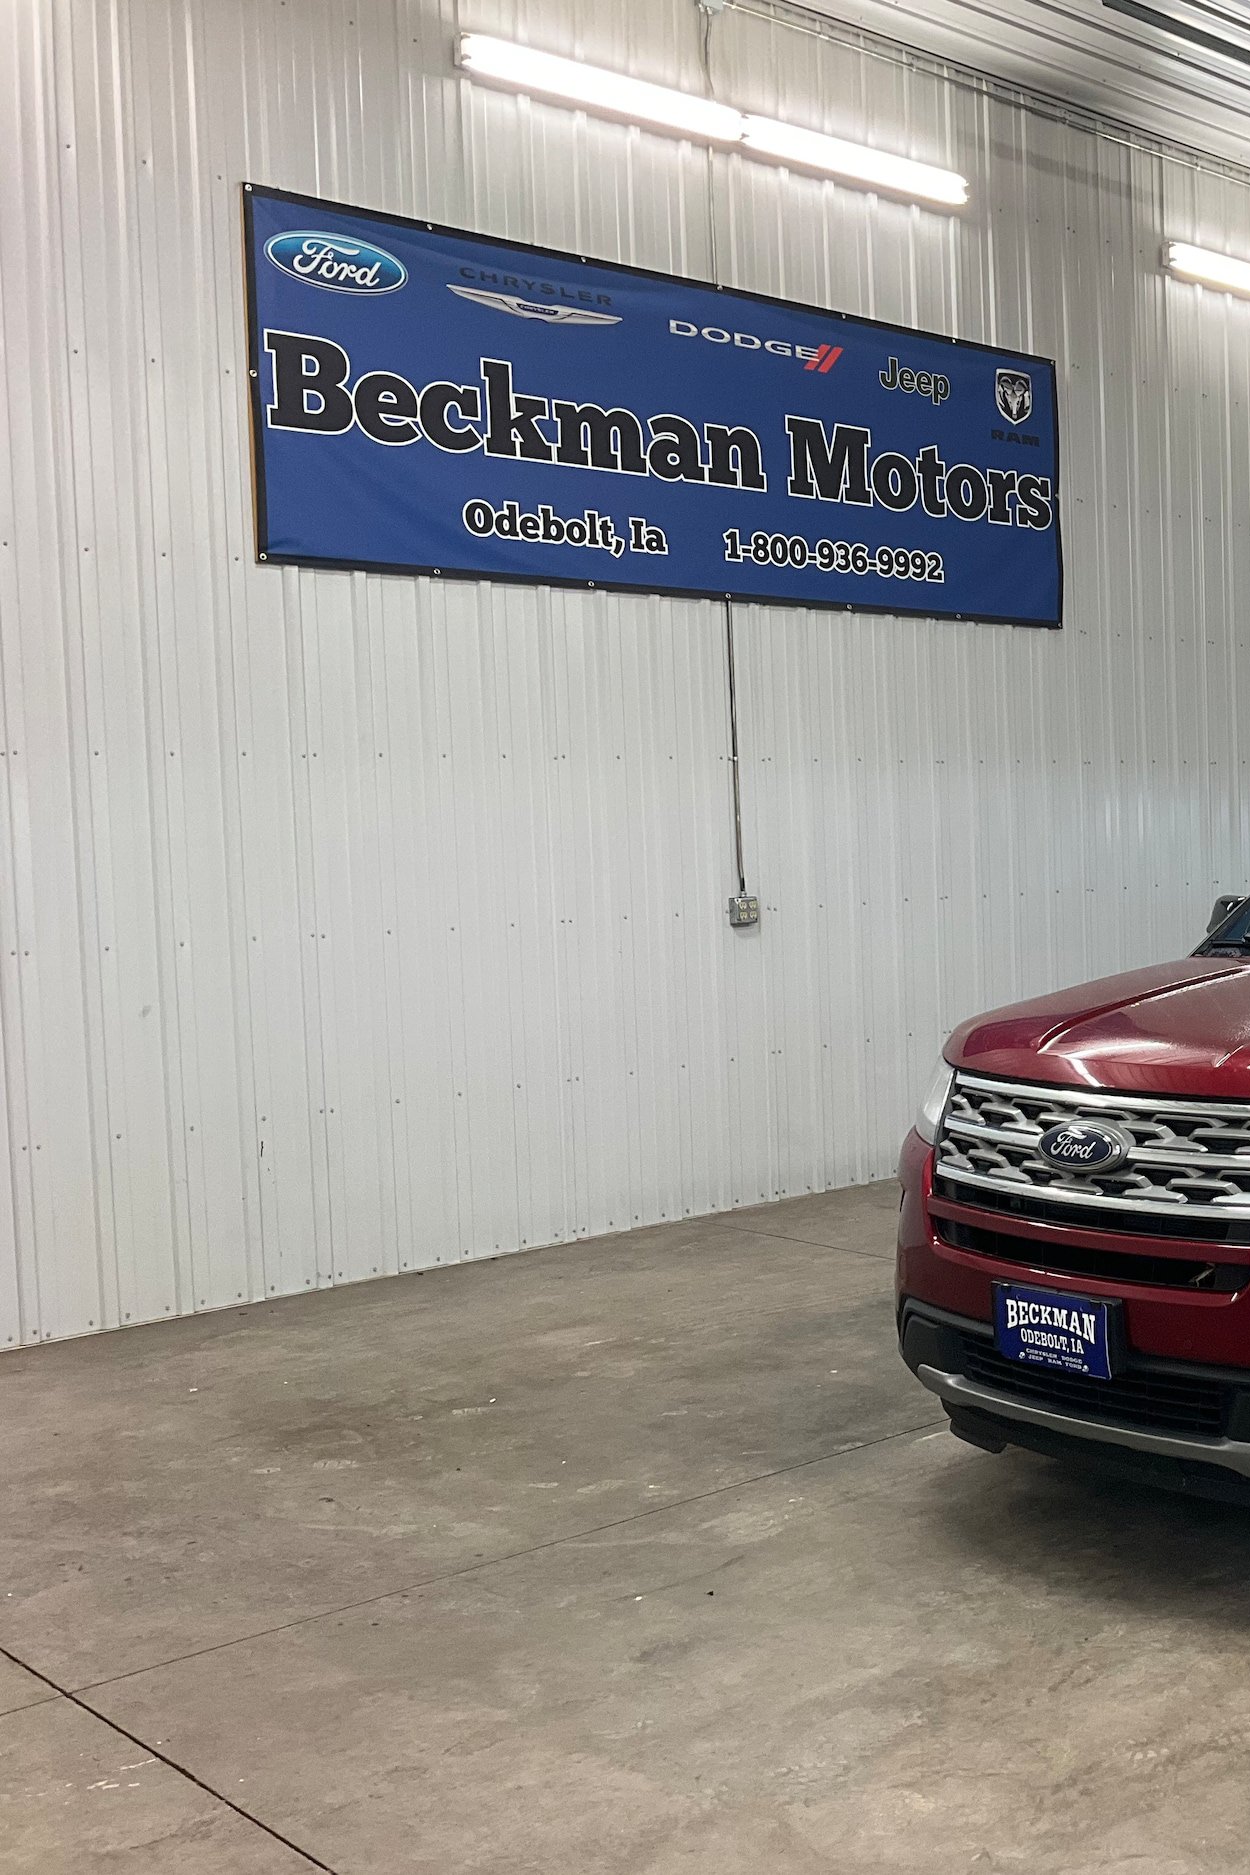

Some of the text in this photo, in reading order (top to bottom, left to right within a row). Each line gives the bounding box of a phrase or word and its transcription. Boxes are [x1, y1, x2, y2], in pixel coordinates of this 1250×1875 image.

[292, 238, 381, 289] Ford
[458, 265, 613, 308] CHRYSLER
[668, 318, 821, 362] DODGE
[878, 356, 951, 406] Jeep
[263, 328, 1053, 531] Beckman Motors
[990, 429, 1041, 448] RAM
[462, 498, 669, 558] Odebolt, Ia
[722, 527, 945, 583] 1-800-936-9992
[1050, 1130, 1097, 1160] Ford
[1006, 1298, 1096, 1345] BECKMAN
